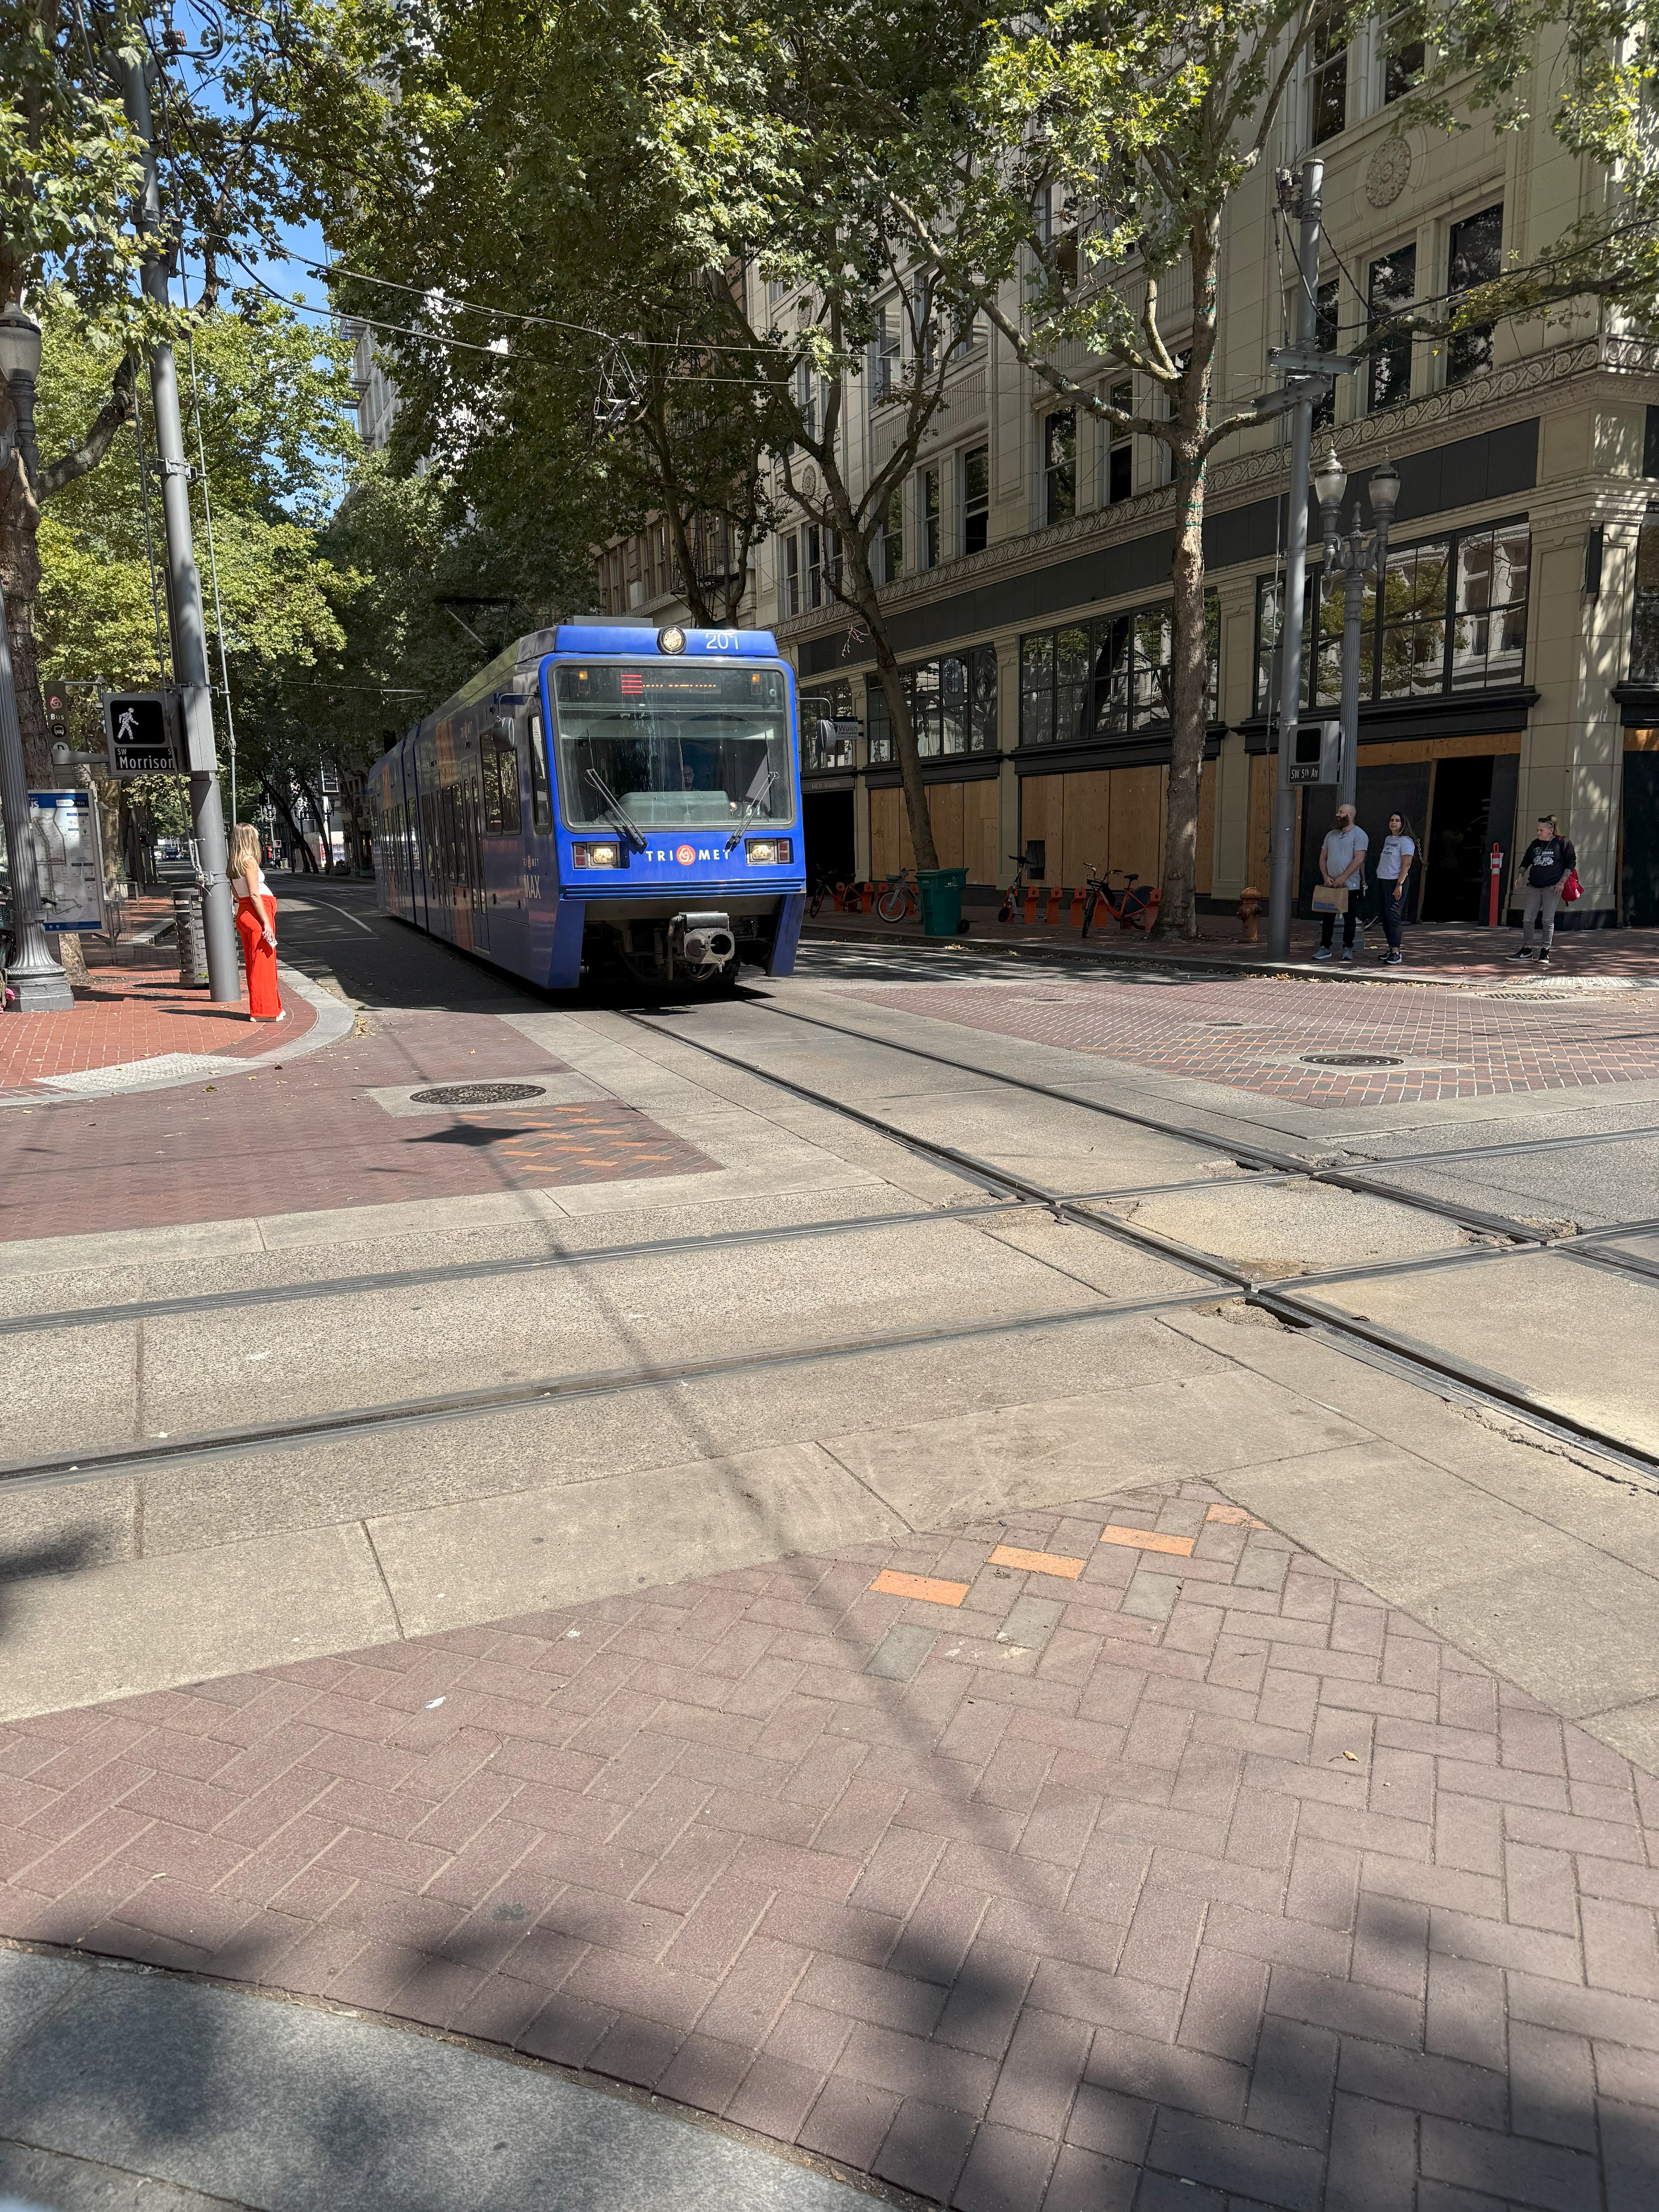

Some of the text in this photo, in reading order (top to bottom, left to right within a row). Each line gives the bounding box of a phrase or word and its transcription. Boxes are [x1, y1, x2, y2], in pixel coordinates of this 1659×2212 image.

[706, 632, 738, 649] 201
[120, 756, 175, 769] Morrison
[1291, 769, 1300, 779] SW
[1311, 768, 1318, 778] Av
[646, 849, 730, 862] TRI MET
[524, 875, 541, 899] MAX
